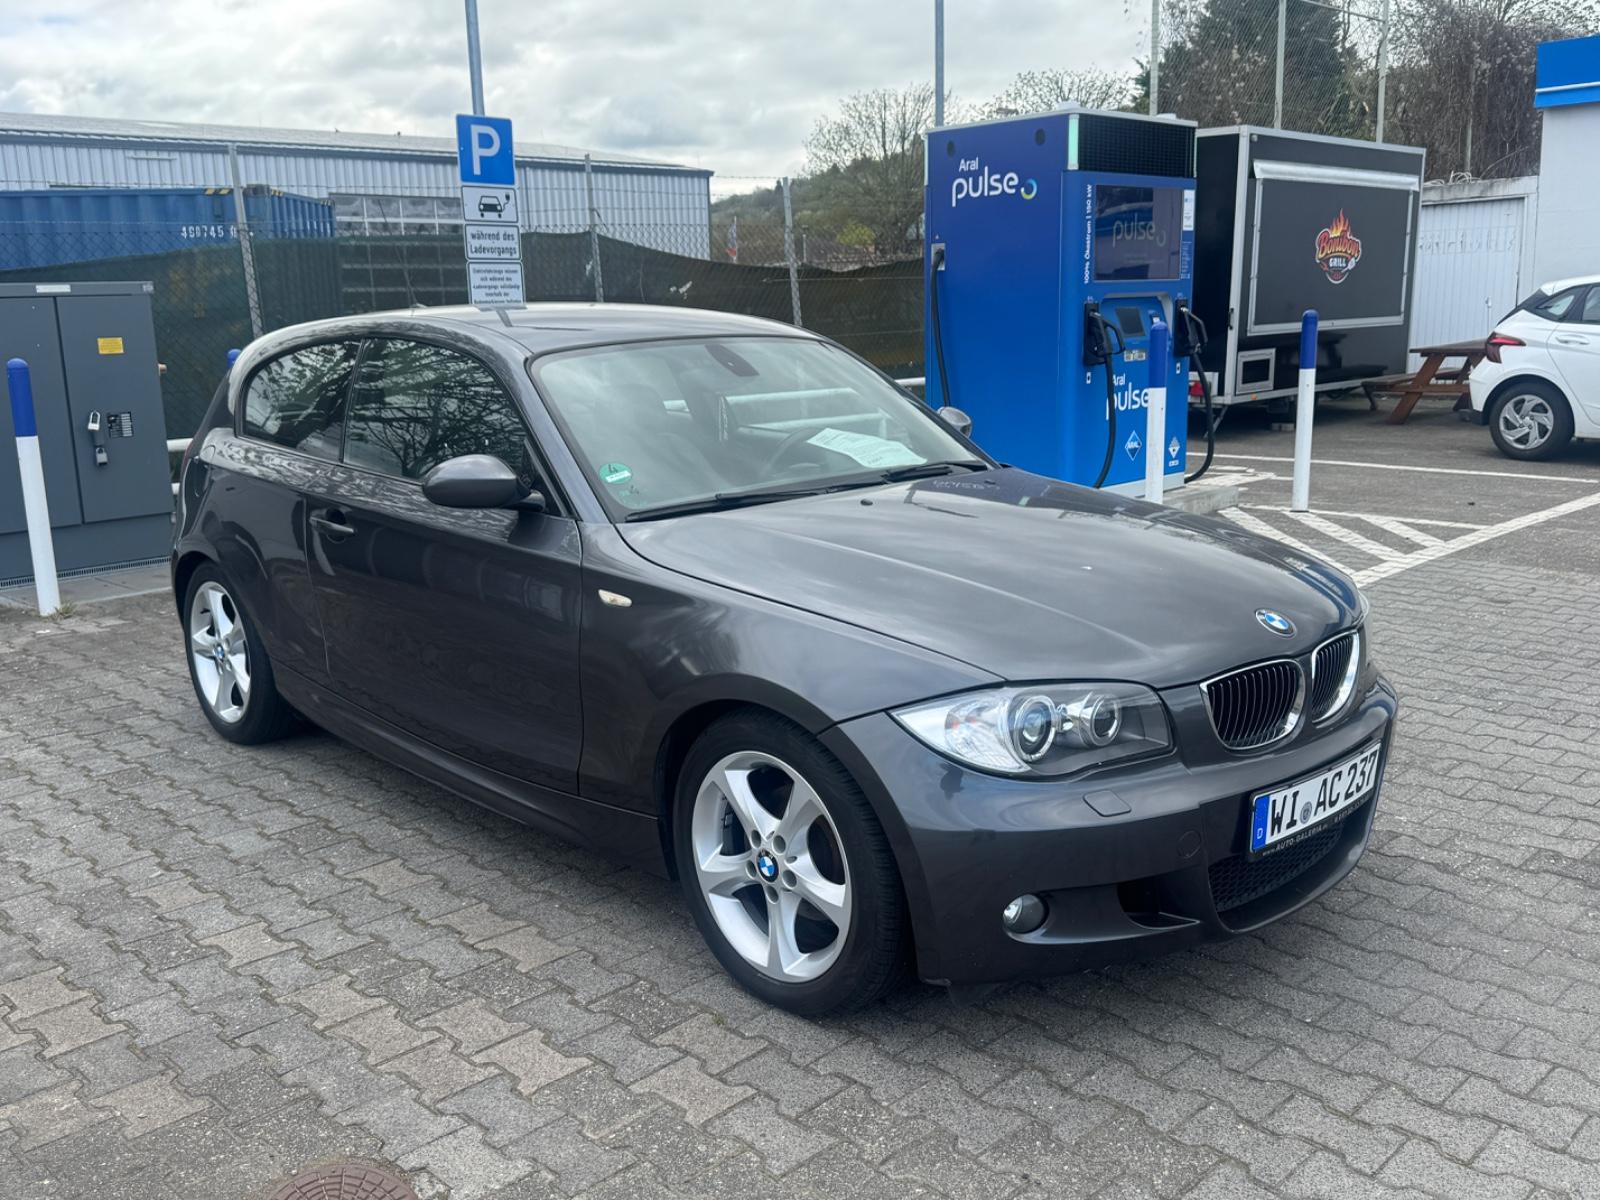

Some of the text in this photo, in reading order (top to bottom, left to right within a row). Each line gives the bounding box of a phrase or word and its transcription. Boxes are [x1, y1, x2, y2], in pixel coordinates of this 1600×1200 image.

[470, 124, 501, 176] P
[958, 156, 979, 172] Aral
[952, 165, 1019, 208] pulse
[470, 230, 515, 241] während des
[1112, 212, 1155, 249] pulse
[470, 244, 517, 256] Ladevorgangs
[1329, 257, 1347, 268] GRILL
[1270, 790, 1300, 837] WI
[1314, 770, 1342, 816] AC
[1344, 749, 1378, 801] 237
[1256, 827, 1264, 840] D
